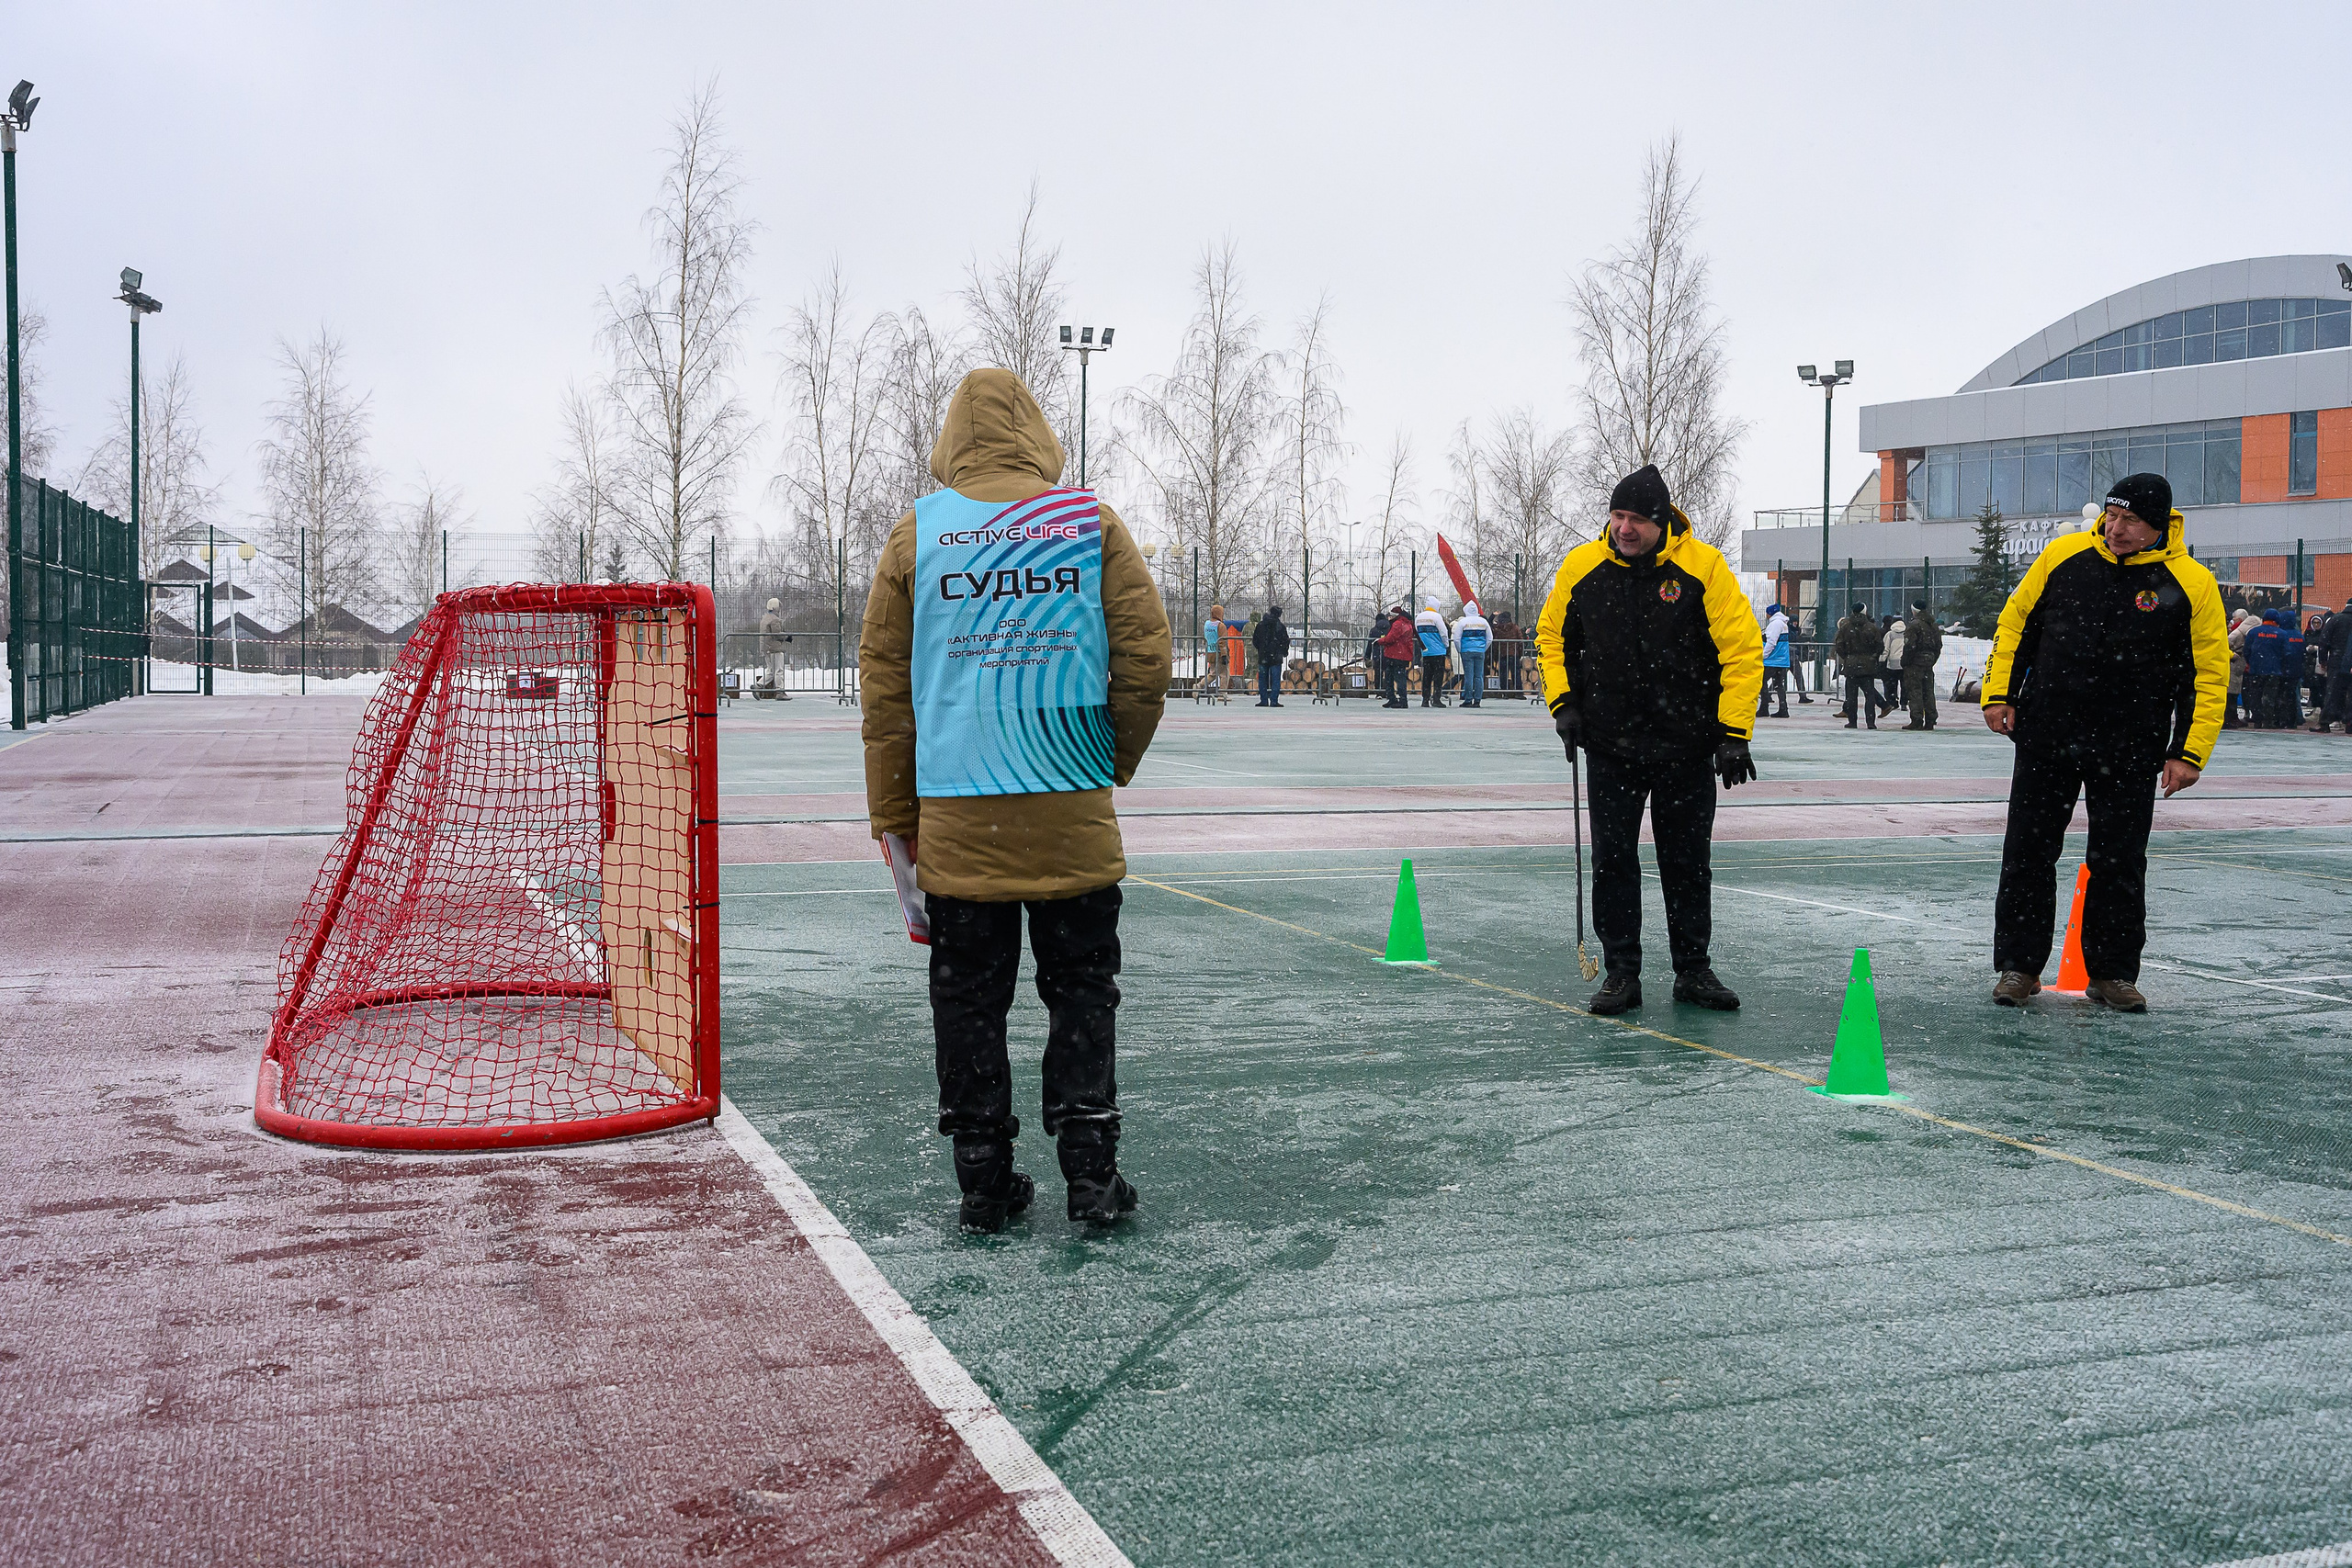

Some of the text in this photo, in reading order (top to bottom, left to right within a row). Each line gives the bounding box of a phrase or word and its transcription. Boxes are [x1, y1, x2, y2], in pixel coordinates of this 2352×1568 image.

[1024, 524, 1078, 540] LIFE
[940, 567, 1081, 602] СУДЬЯ
[999, 618, 1026, 628] ООО
[947, 629, 1077, 645] «АКТИВНАЯ ЖИЗНЬ»
[948, 644, 1078, 659] организация спортивных
[979, 657, 1049, 670] мероприятий
